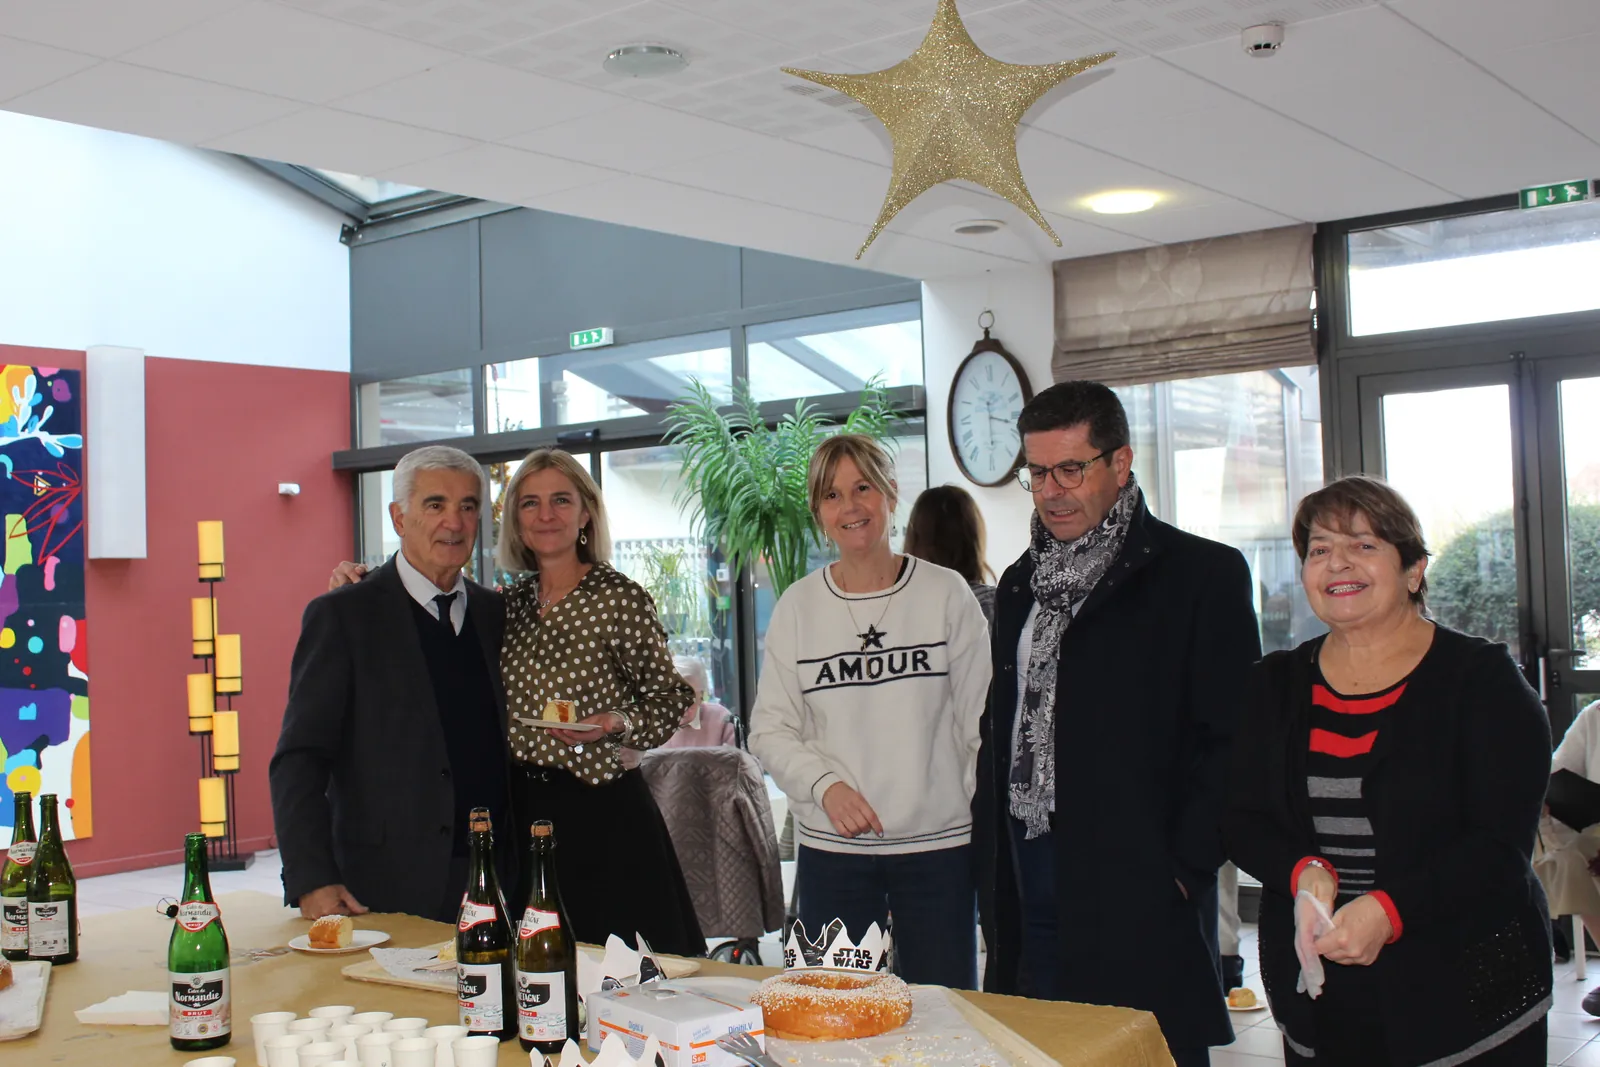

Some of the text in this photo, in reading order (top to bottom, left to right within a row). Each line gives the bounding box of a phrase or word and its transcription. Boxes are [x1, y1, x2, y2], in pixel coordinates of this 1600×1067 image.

[815, 649, 931, 685] AMOUR
[6, 911, 28, 920] Norma
[833, 947, 873, 959] STAR
[833, 957, 873, 969] WARS
[174, 989, 220, 1002] Normandie
